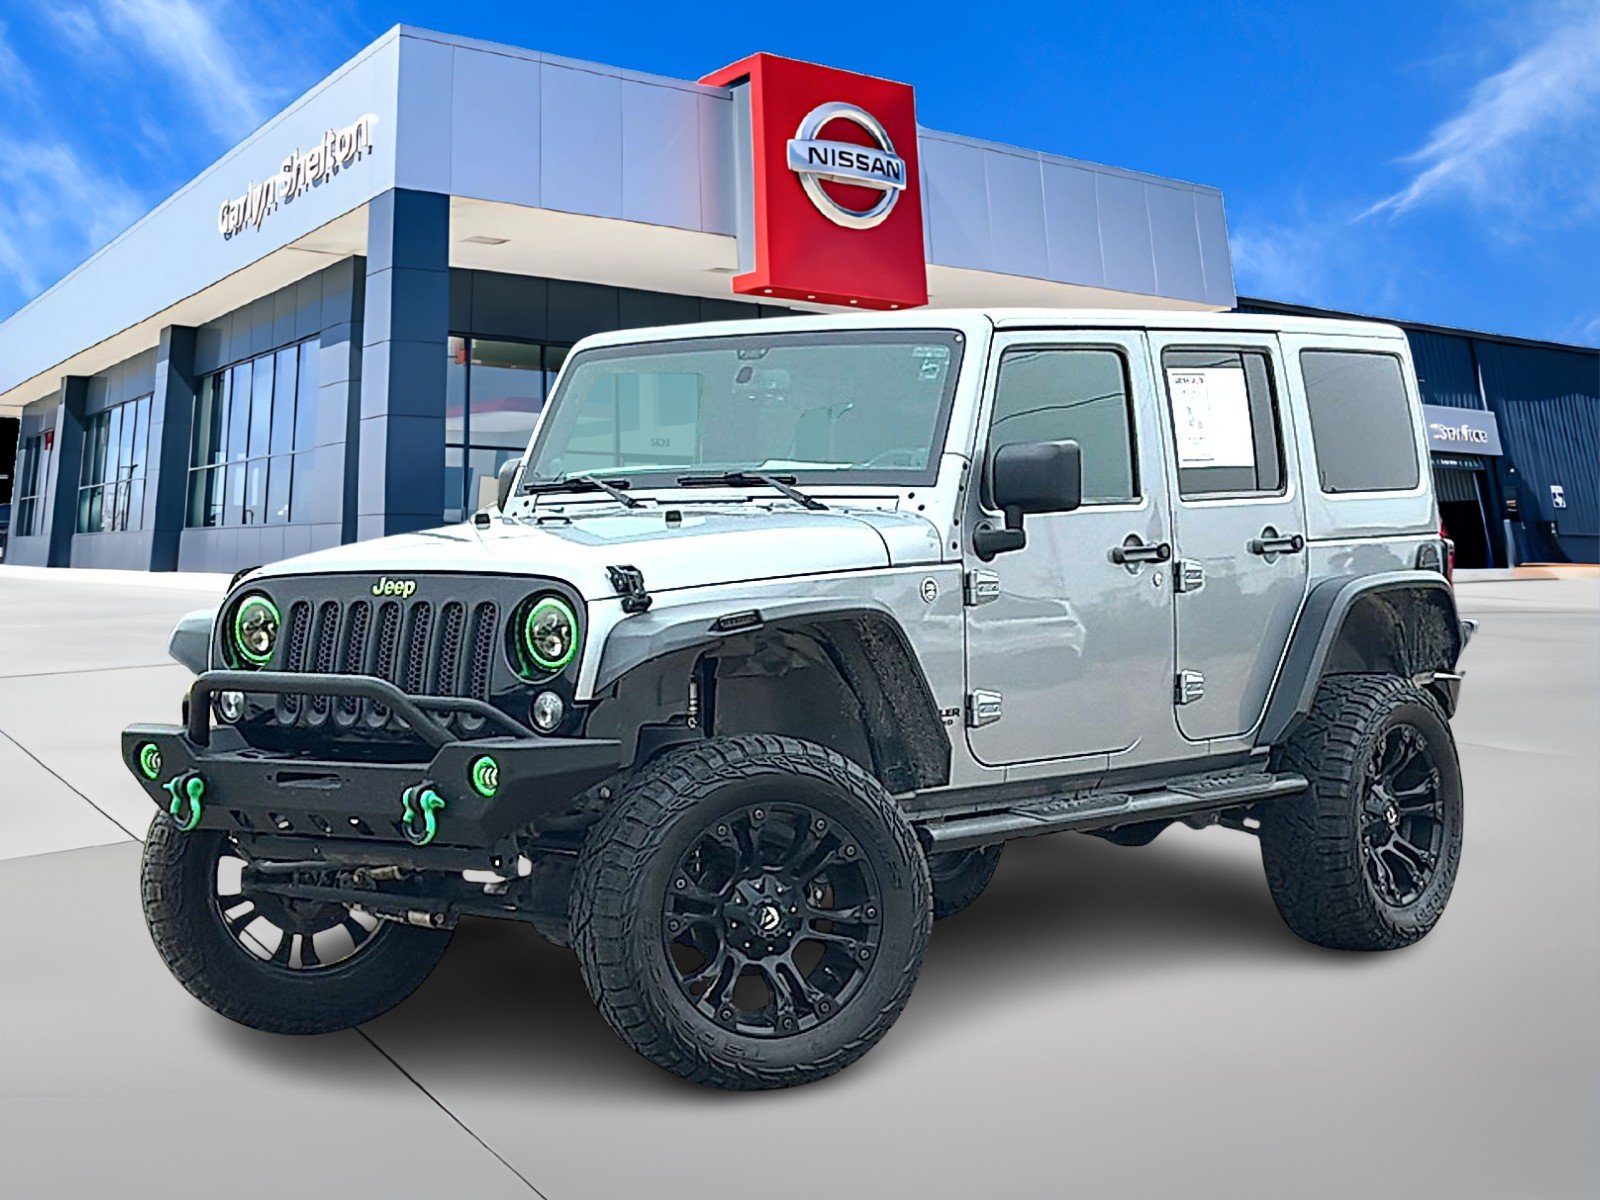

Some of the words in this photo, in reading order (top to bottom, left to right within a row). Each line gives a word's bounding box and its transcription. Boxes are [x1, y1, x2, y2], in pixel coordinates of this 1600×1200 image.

[279, 114, 377, 204] Shelton
[808, 146, 900, 180] NISSAN
[372, 576, 416, 599] Jeep
